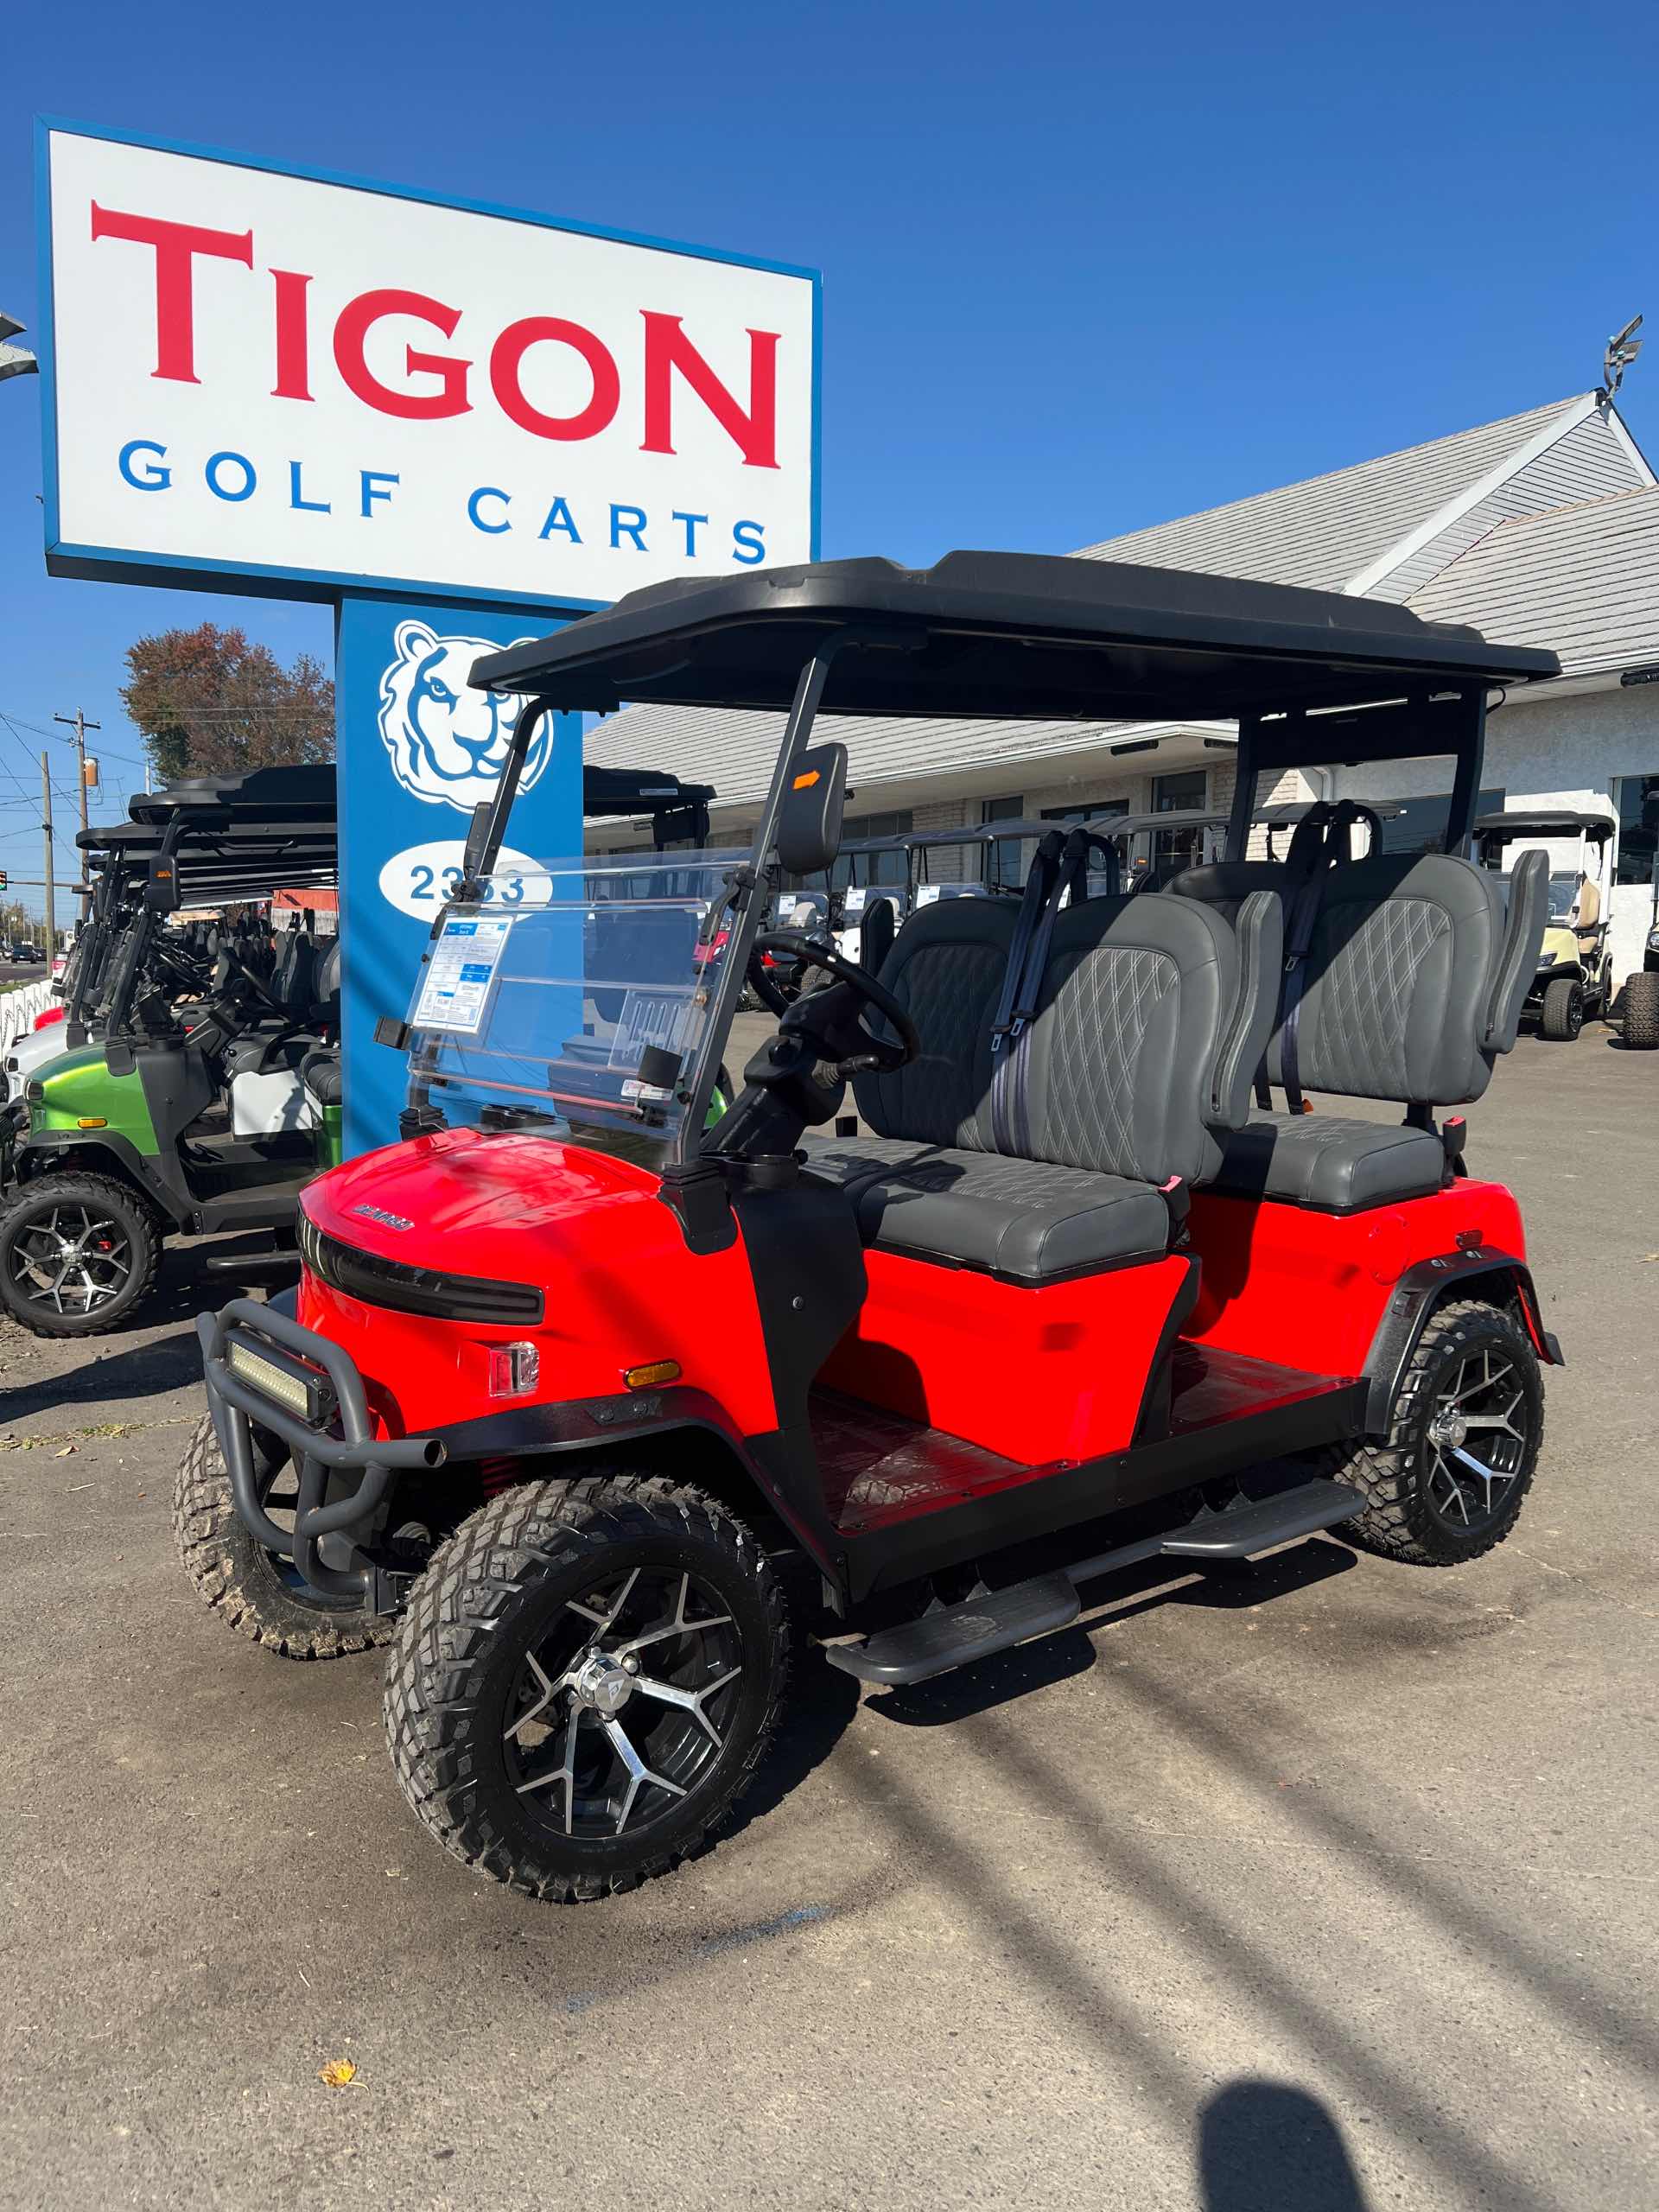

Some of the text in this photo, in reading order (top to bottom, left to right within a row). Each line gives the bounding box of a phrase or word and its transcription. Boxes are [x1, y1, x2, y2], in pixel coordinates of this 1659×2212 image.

[91, 200, 781, 470] TIGON
[118, 439, 766, 565] GOLF CARTS
[410, 865, 524, 906] 233
